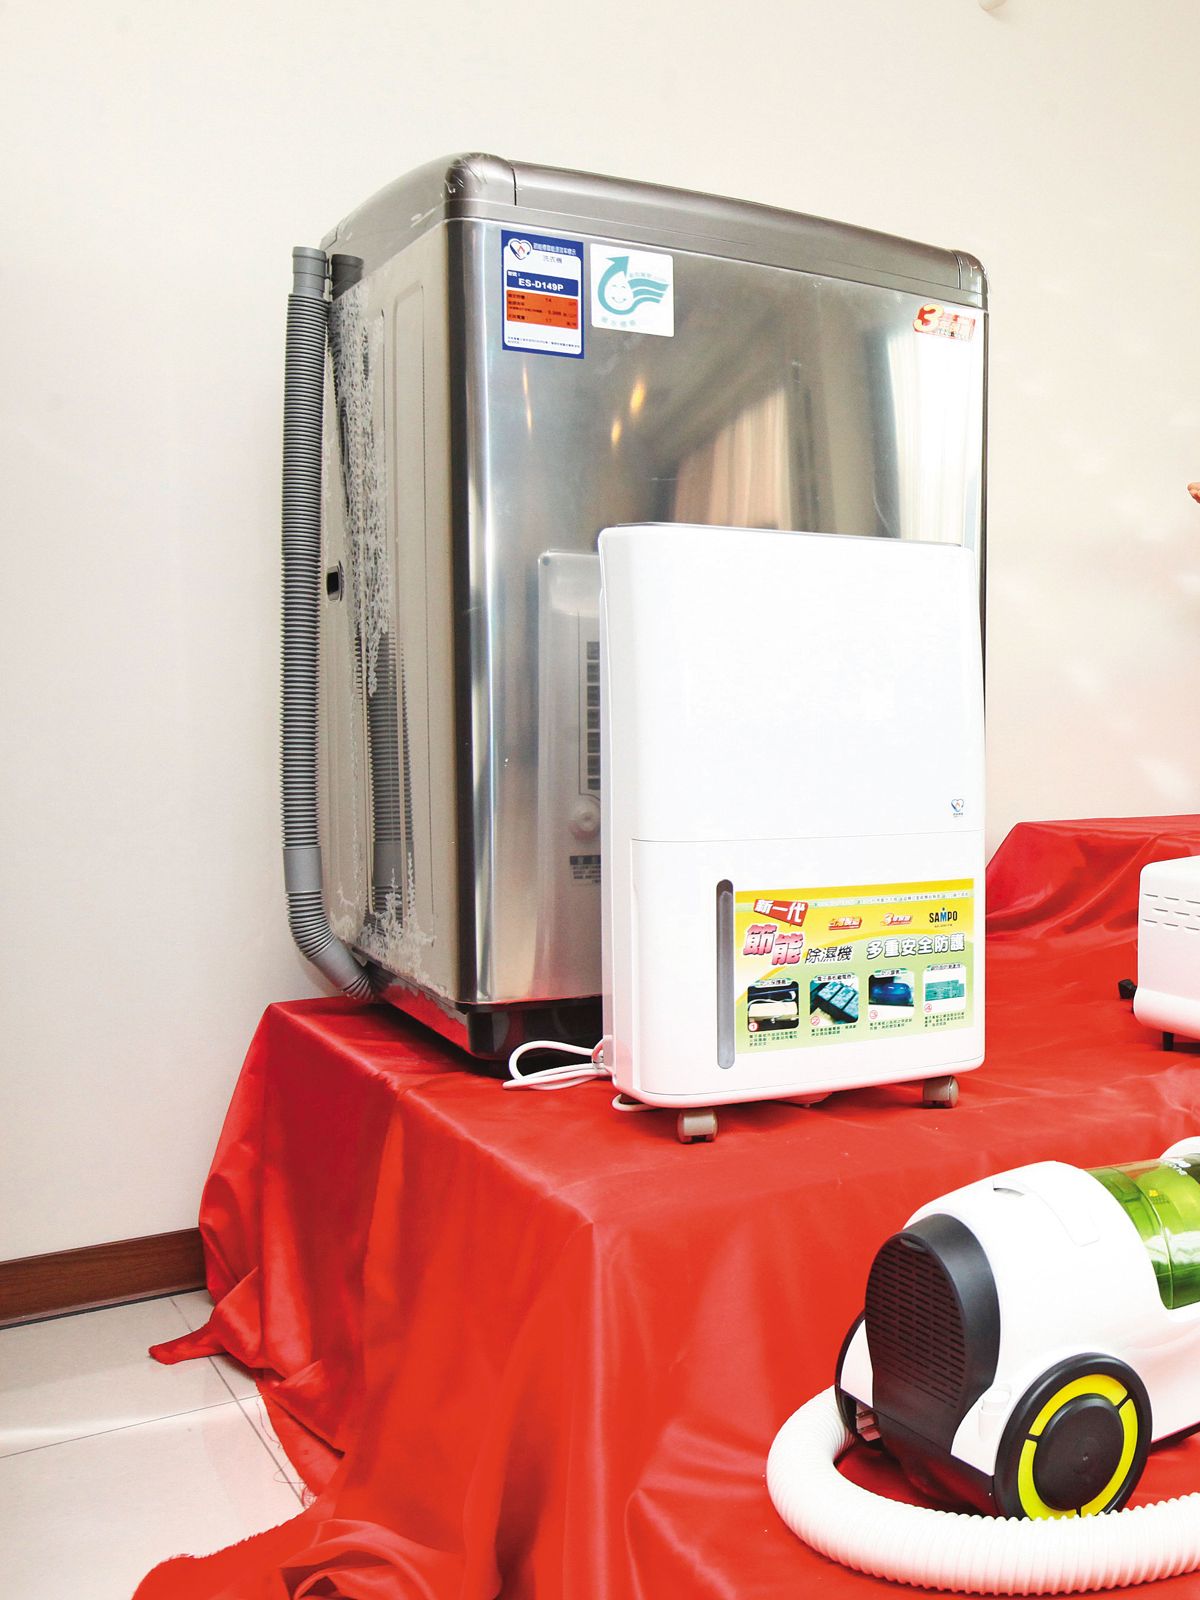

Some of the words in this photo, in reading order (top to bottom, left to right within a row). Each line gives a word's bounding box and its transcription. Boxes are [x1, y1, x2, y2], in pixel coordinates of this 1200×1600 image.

[518, 278, 564, 291] ES-D149P
[754, 899, 806, 923] 新一代
[929, 908, 958, 923] SAMPO
[743, 924, 803, 965] 節能
[805, 945, 853, 964] 除濕機
[867, 933, 965, 960] 多重安全防護
